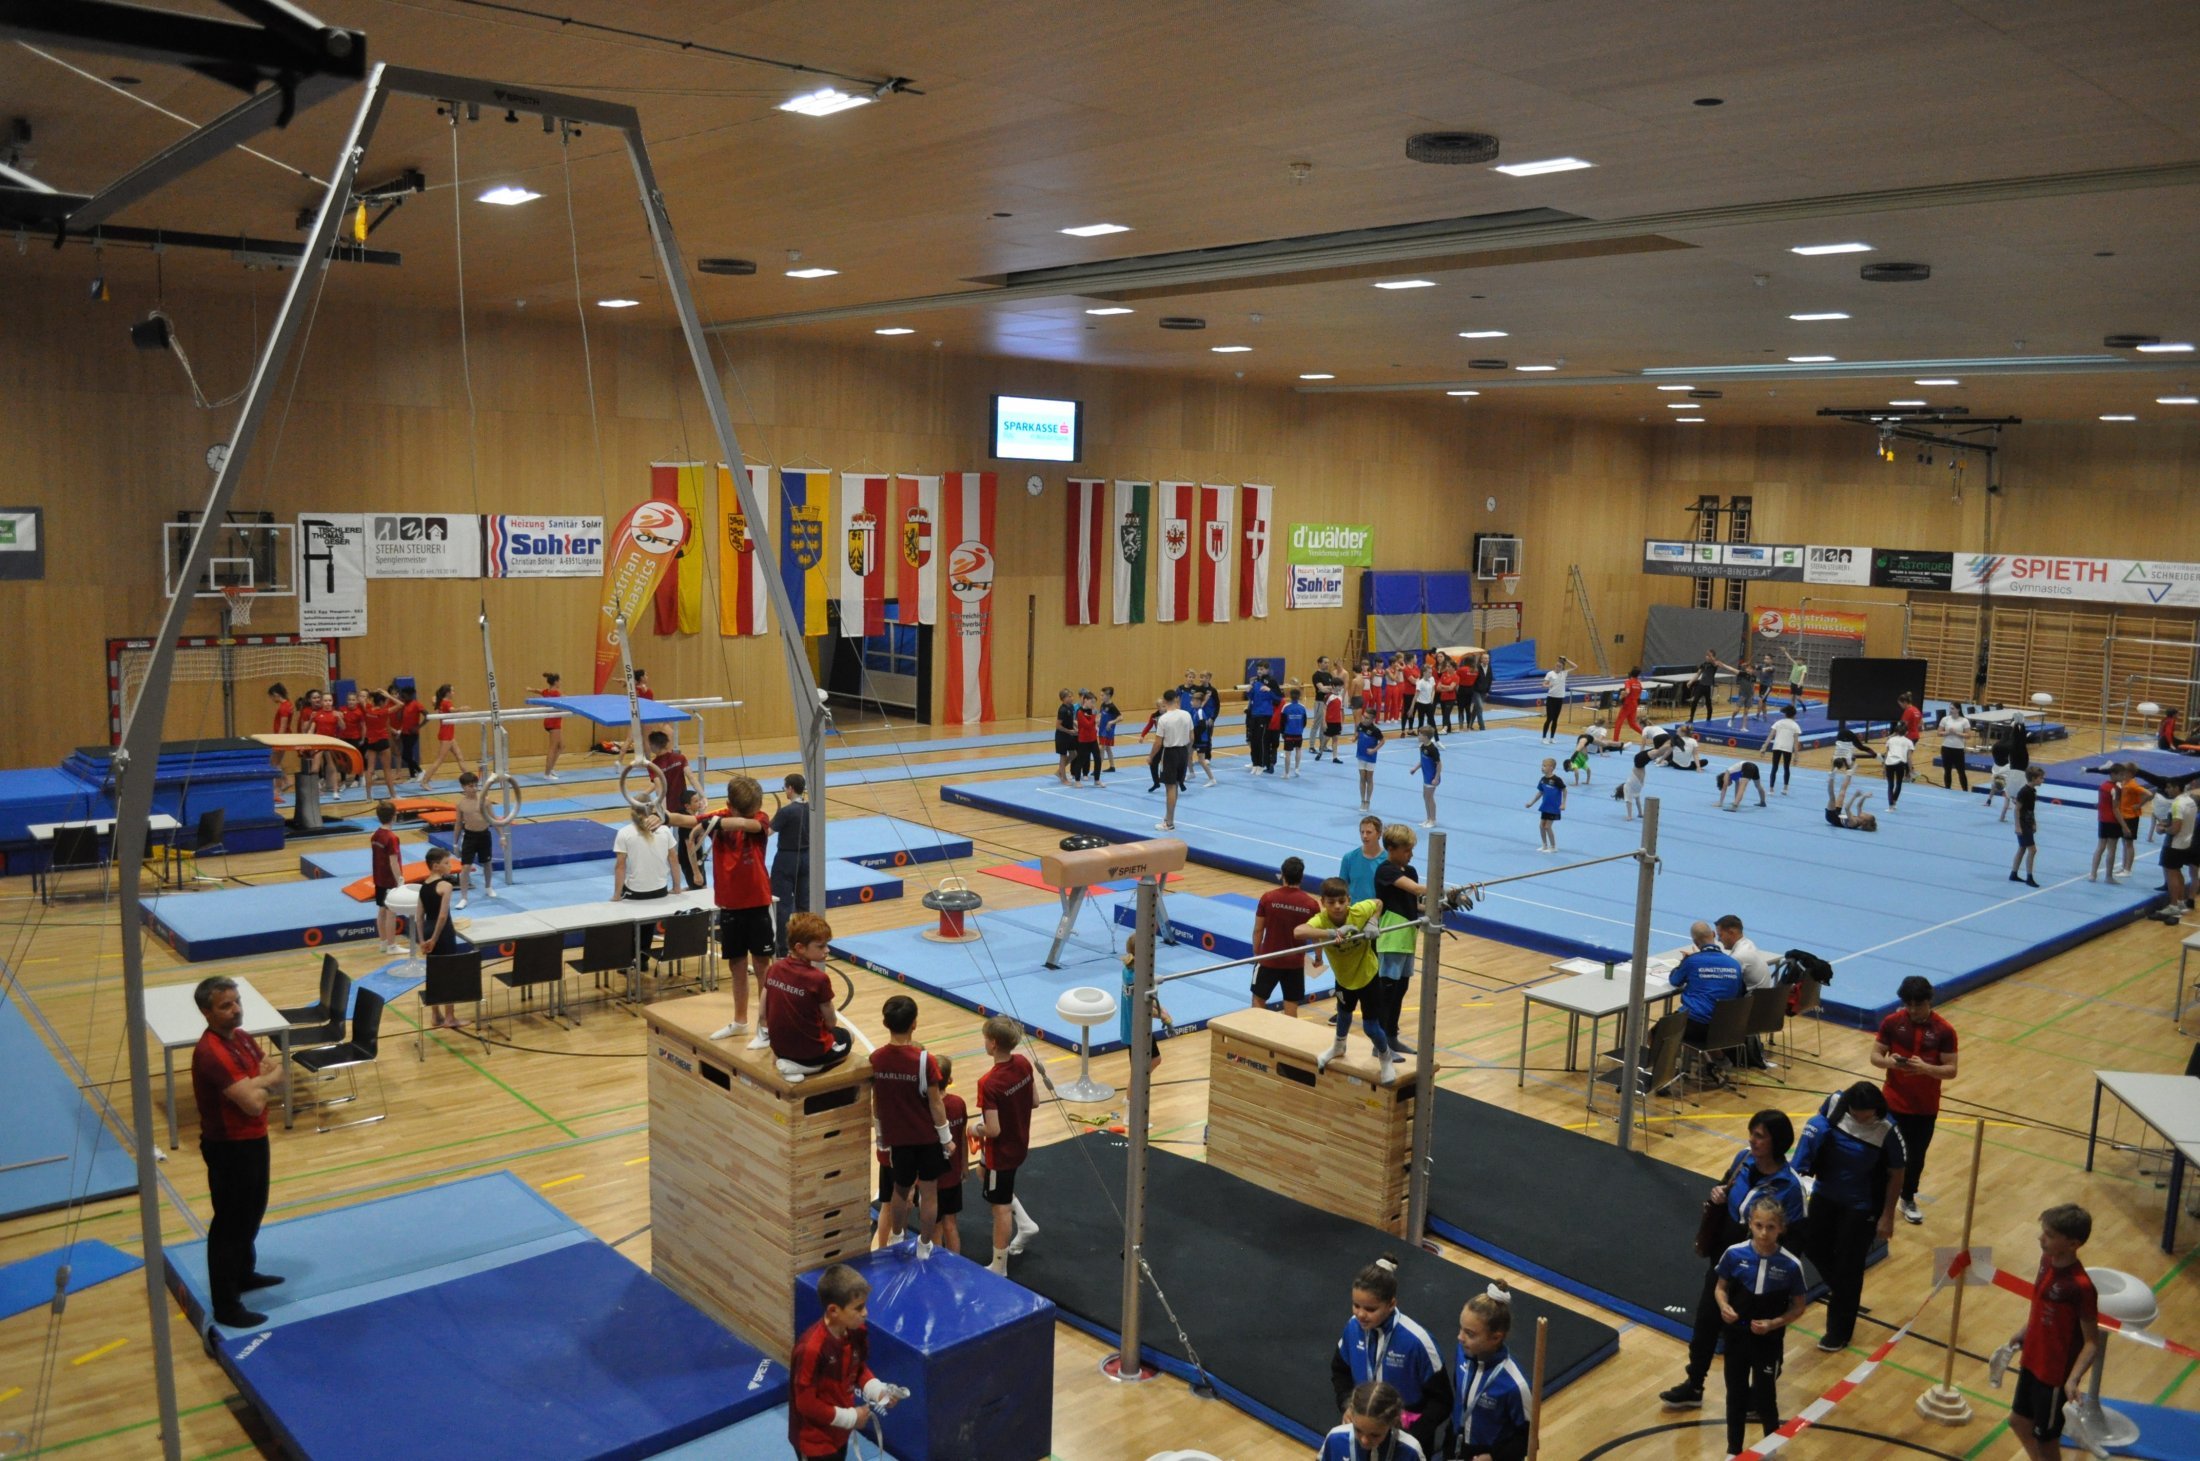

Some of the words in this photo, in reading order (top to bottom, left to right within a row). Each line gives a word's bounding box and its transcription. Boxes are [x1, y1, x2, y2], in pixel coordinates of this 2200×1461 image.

[1004, 421, 1058, 434] SPARKASSE
[511, 520, 545, 530] Heizung
[549, 519, 578, 528] Sanitär
[581, 520, 602, 528] Solar
[511, 533, 602, 555] Sohler
[1293, 526, 1368, 549] d'wälder
[376, 544, 405, 554] STEFAN
[407, 544, 441, 554] STEURER
[375, 556, 427, 565] Spenglermeister
[1673, 564, 1772, 577] WWW.SPORT-BINDER.AT
[2011, 558, 2108, 583] SPIETH
[2151, 571, 2200, 581] SCHNEIDER
[602, 552, 642, 618] Austrian
[1296, 576, 1342, 592] Sohler
[2009, 581, 2073, 595] Gymnastics
[607, 560, 656, 645] Gnastics
[1788, 620, 1857, 633] Gymnastics
[625, 665, 638, 718] SPIETH
[489, 672, 500, 730] SPIETH
[1119, 864, 1147, 876] SPIETH
[1271, 902, 1311, 914] VORARLBERG
[348, 926, 375, 936] SPIETH
[1175, 930, 1194, 940] SPIETH
[1174, 1025, 1197, 1036] SPIETH
[873, 1072, 918, 1082] ORARLBERG
[752, 1359, 772, 1382] SPIETH
